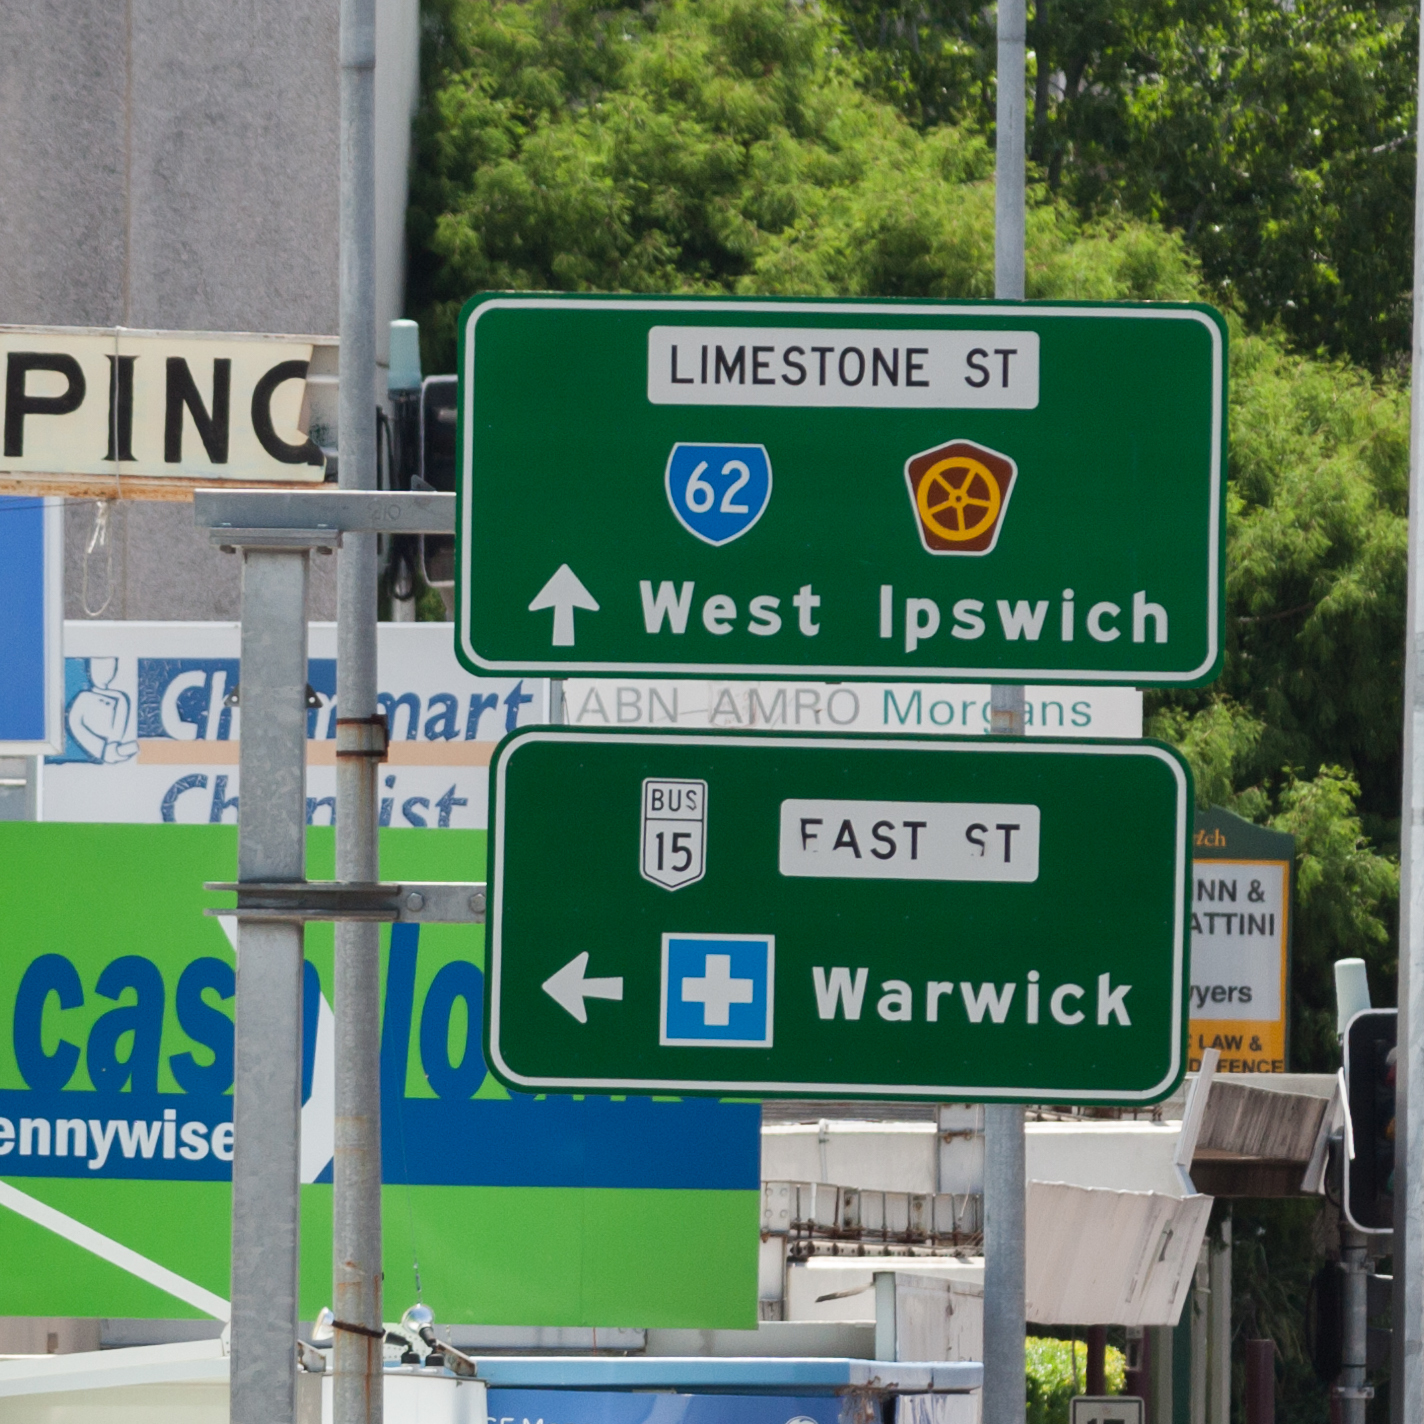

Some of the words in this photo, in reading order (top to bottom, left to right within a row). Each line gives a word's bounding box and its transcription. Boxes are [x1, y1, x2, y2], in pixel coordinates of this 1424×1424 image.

[669, 345, 930, 387] LIMESTONE
[964, 349, 1018, 389] ST
[684, 458, 750, 516] 62
[639, 580, 821, 637] West
[880, 585, 1170, 653] Ipswich
[576, 686, 679, 724] ABN
[708, 687, 861, 727] AMRO
[651, 788, 698, 812] BUS
[655, 831, 693, 872] 15
[965, 822, 1021, 864] ST
[1248, 879, 1266, 903] &
[812, 966, 1133, 1027] Warwick
[1198, 1033, 1243, 1051] LAW
[1249, 1035, 1263, 1052] &
